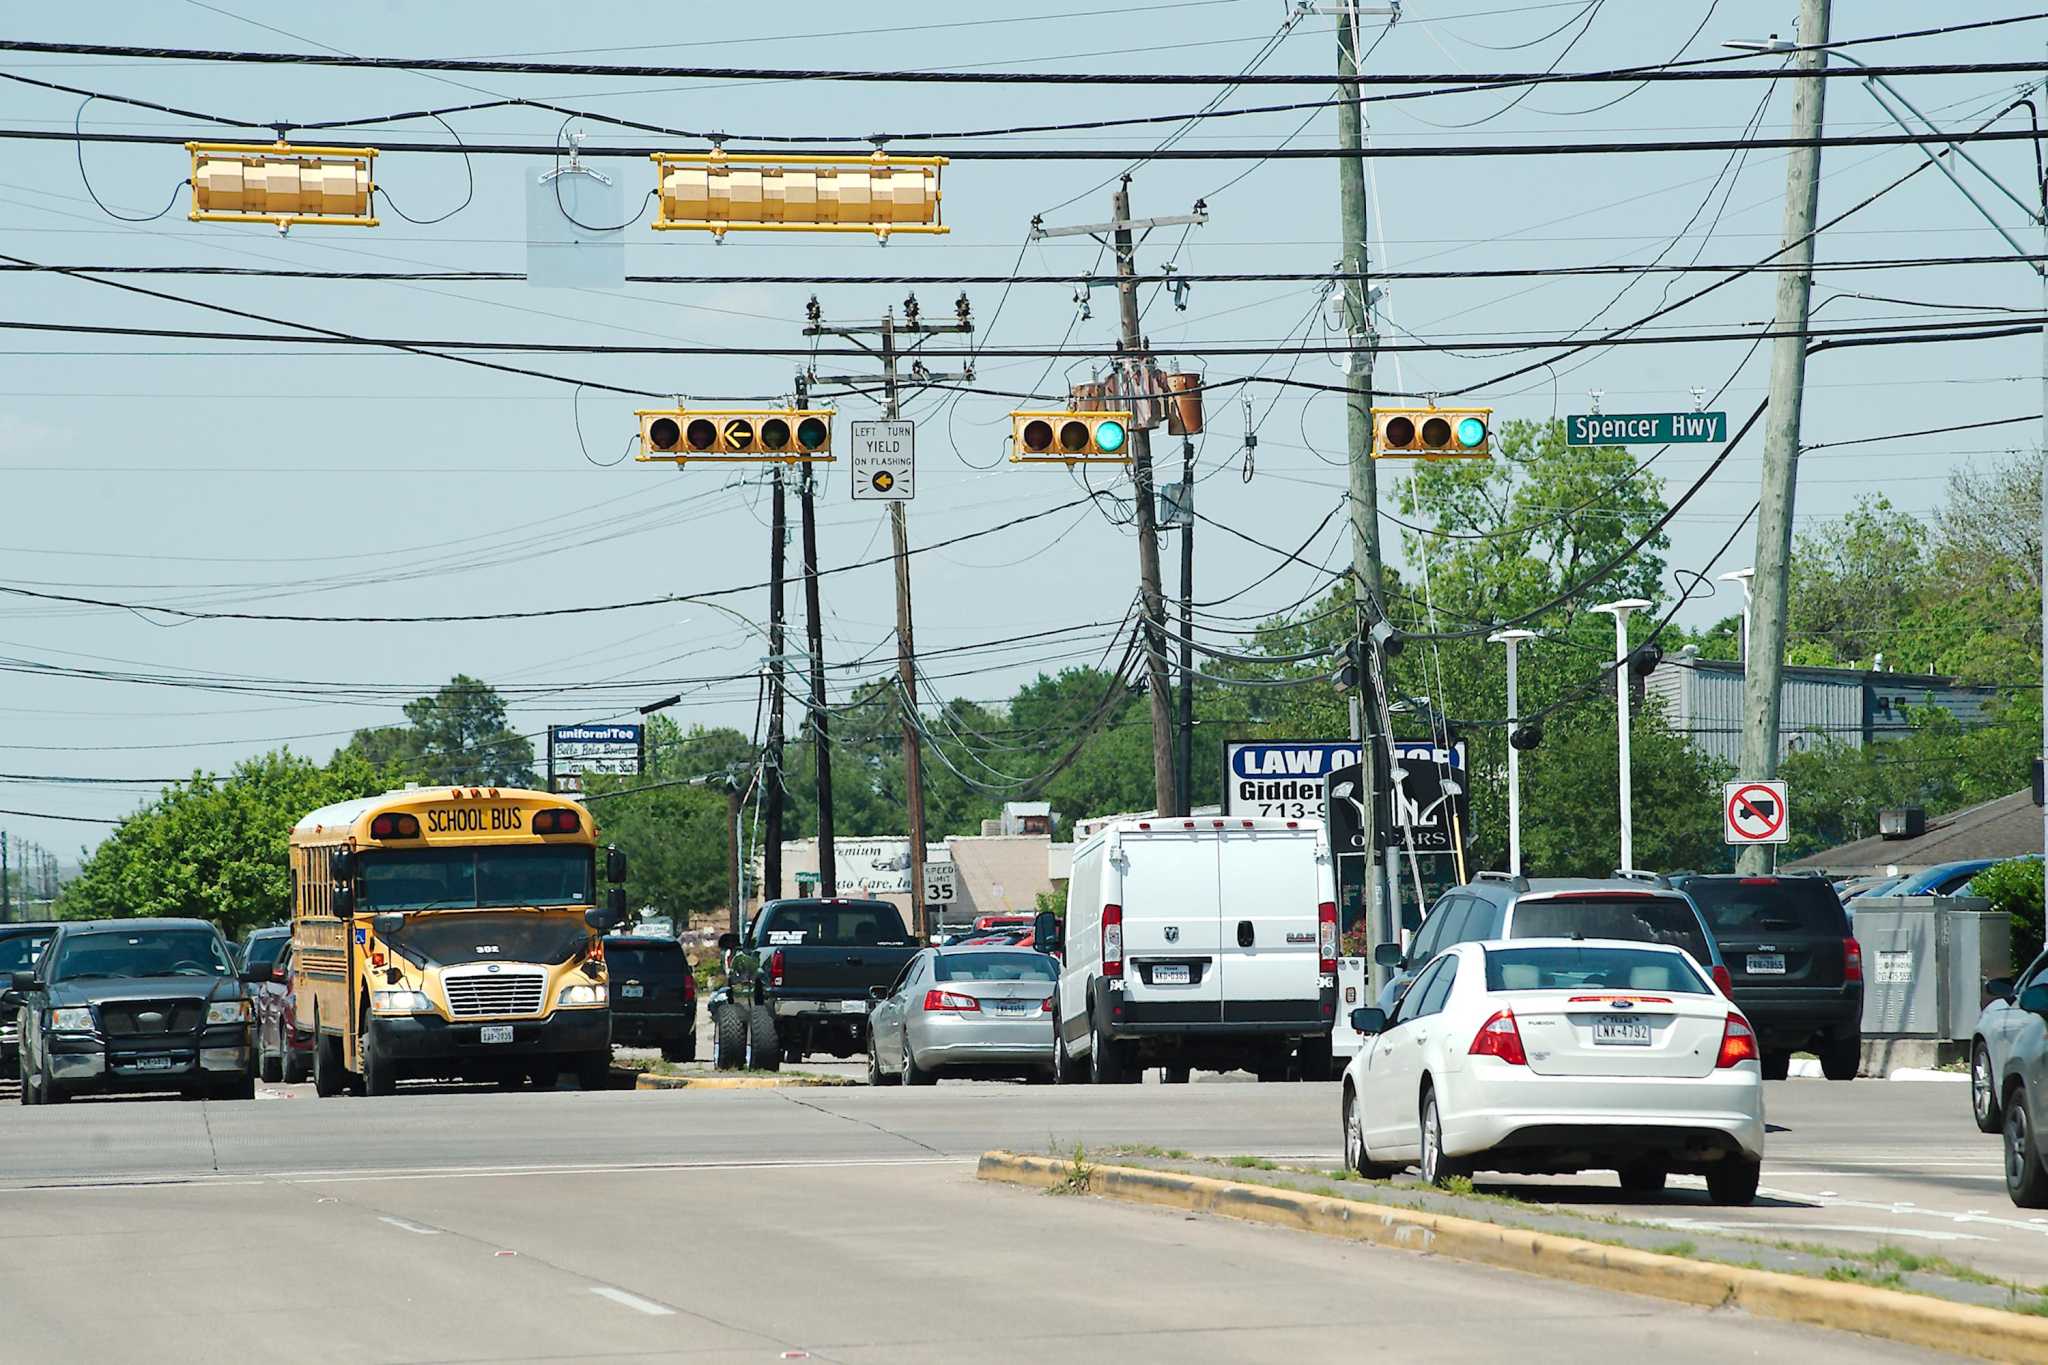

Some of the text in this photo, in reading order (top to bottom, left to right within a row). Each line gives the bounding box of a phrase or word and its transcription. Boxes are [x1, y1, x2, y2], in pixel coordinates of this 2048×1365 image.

[855, 427, 911, 437] LEFT TURN
[1576, 415, 1718, 444] Spencer Hwy
[866, 440, 900, 453] YIELD
[854, 457, 912, 466] ON FLASHING
[1244, 750, 1323, 774] LAW
[428, 806, 522, 832] SCHOOL BUS
[926, 866, 953, 874] SPEED
[928, 875, 950, 883] LIMIT
[928, 884, 953, 900] 35
[475, 945, 500, 954] 302
